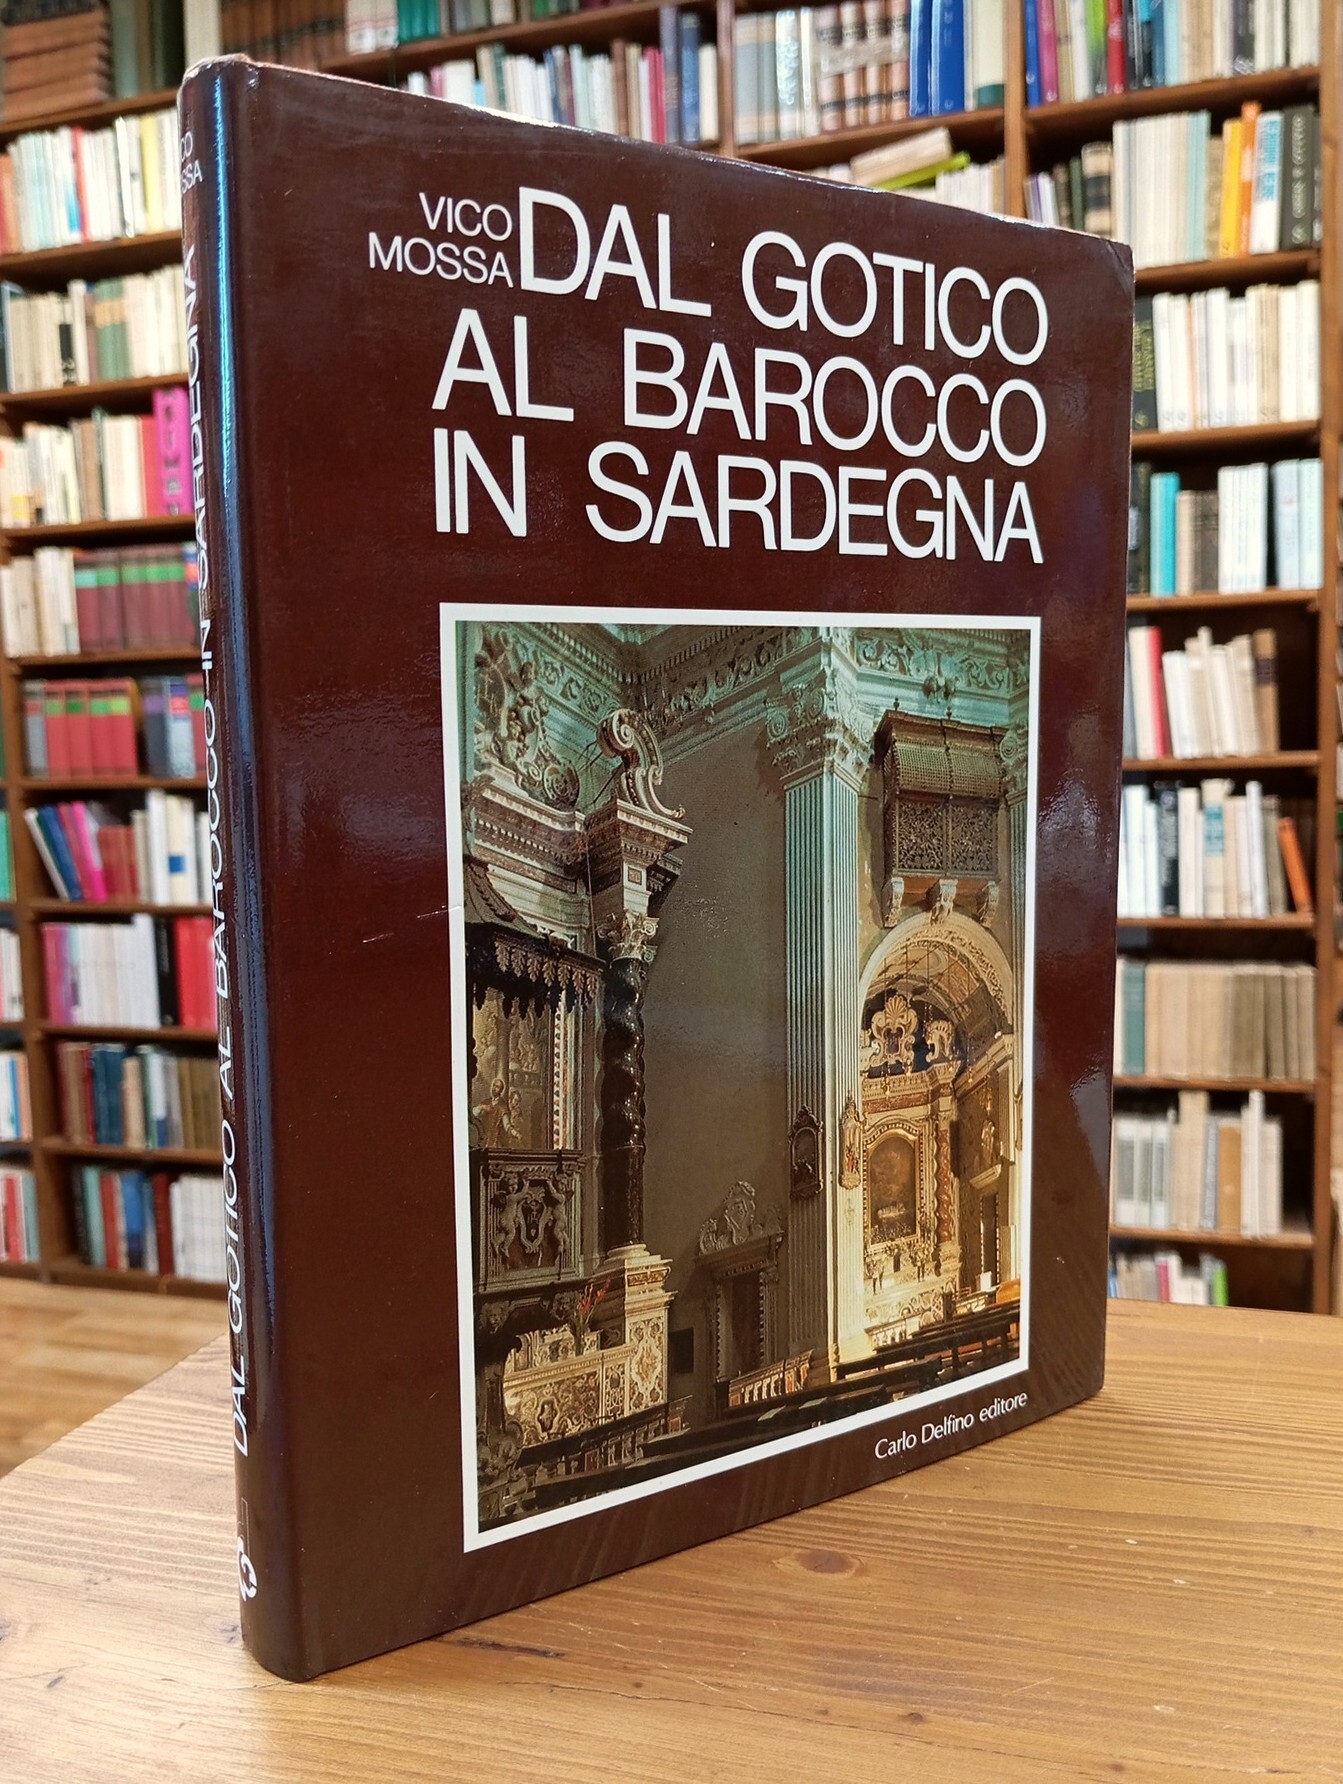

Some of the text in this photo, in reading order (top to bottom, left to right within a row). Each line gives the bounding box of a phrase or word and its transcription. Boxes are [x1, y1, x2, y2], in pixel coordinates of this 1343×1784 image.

[368, 231, 514, 288] MOSSA
[419, 192, 513, 241] VICO
[518, 186, 712, 318] DAL
[741, 230, 1049, 366] GOTICO
[432, 307, 574, 422] AL
[623, 327, 1047, 467] BAROCCO
[433, 427, 1044, 564] IN SARDEGNA
[218, 1026, 233, 1100] AL
[231, 1354, 248, 1457] DAL
[874, 1391, 1028, 1459] Carlo Delfino editore
